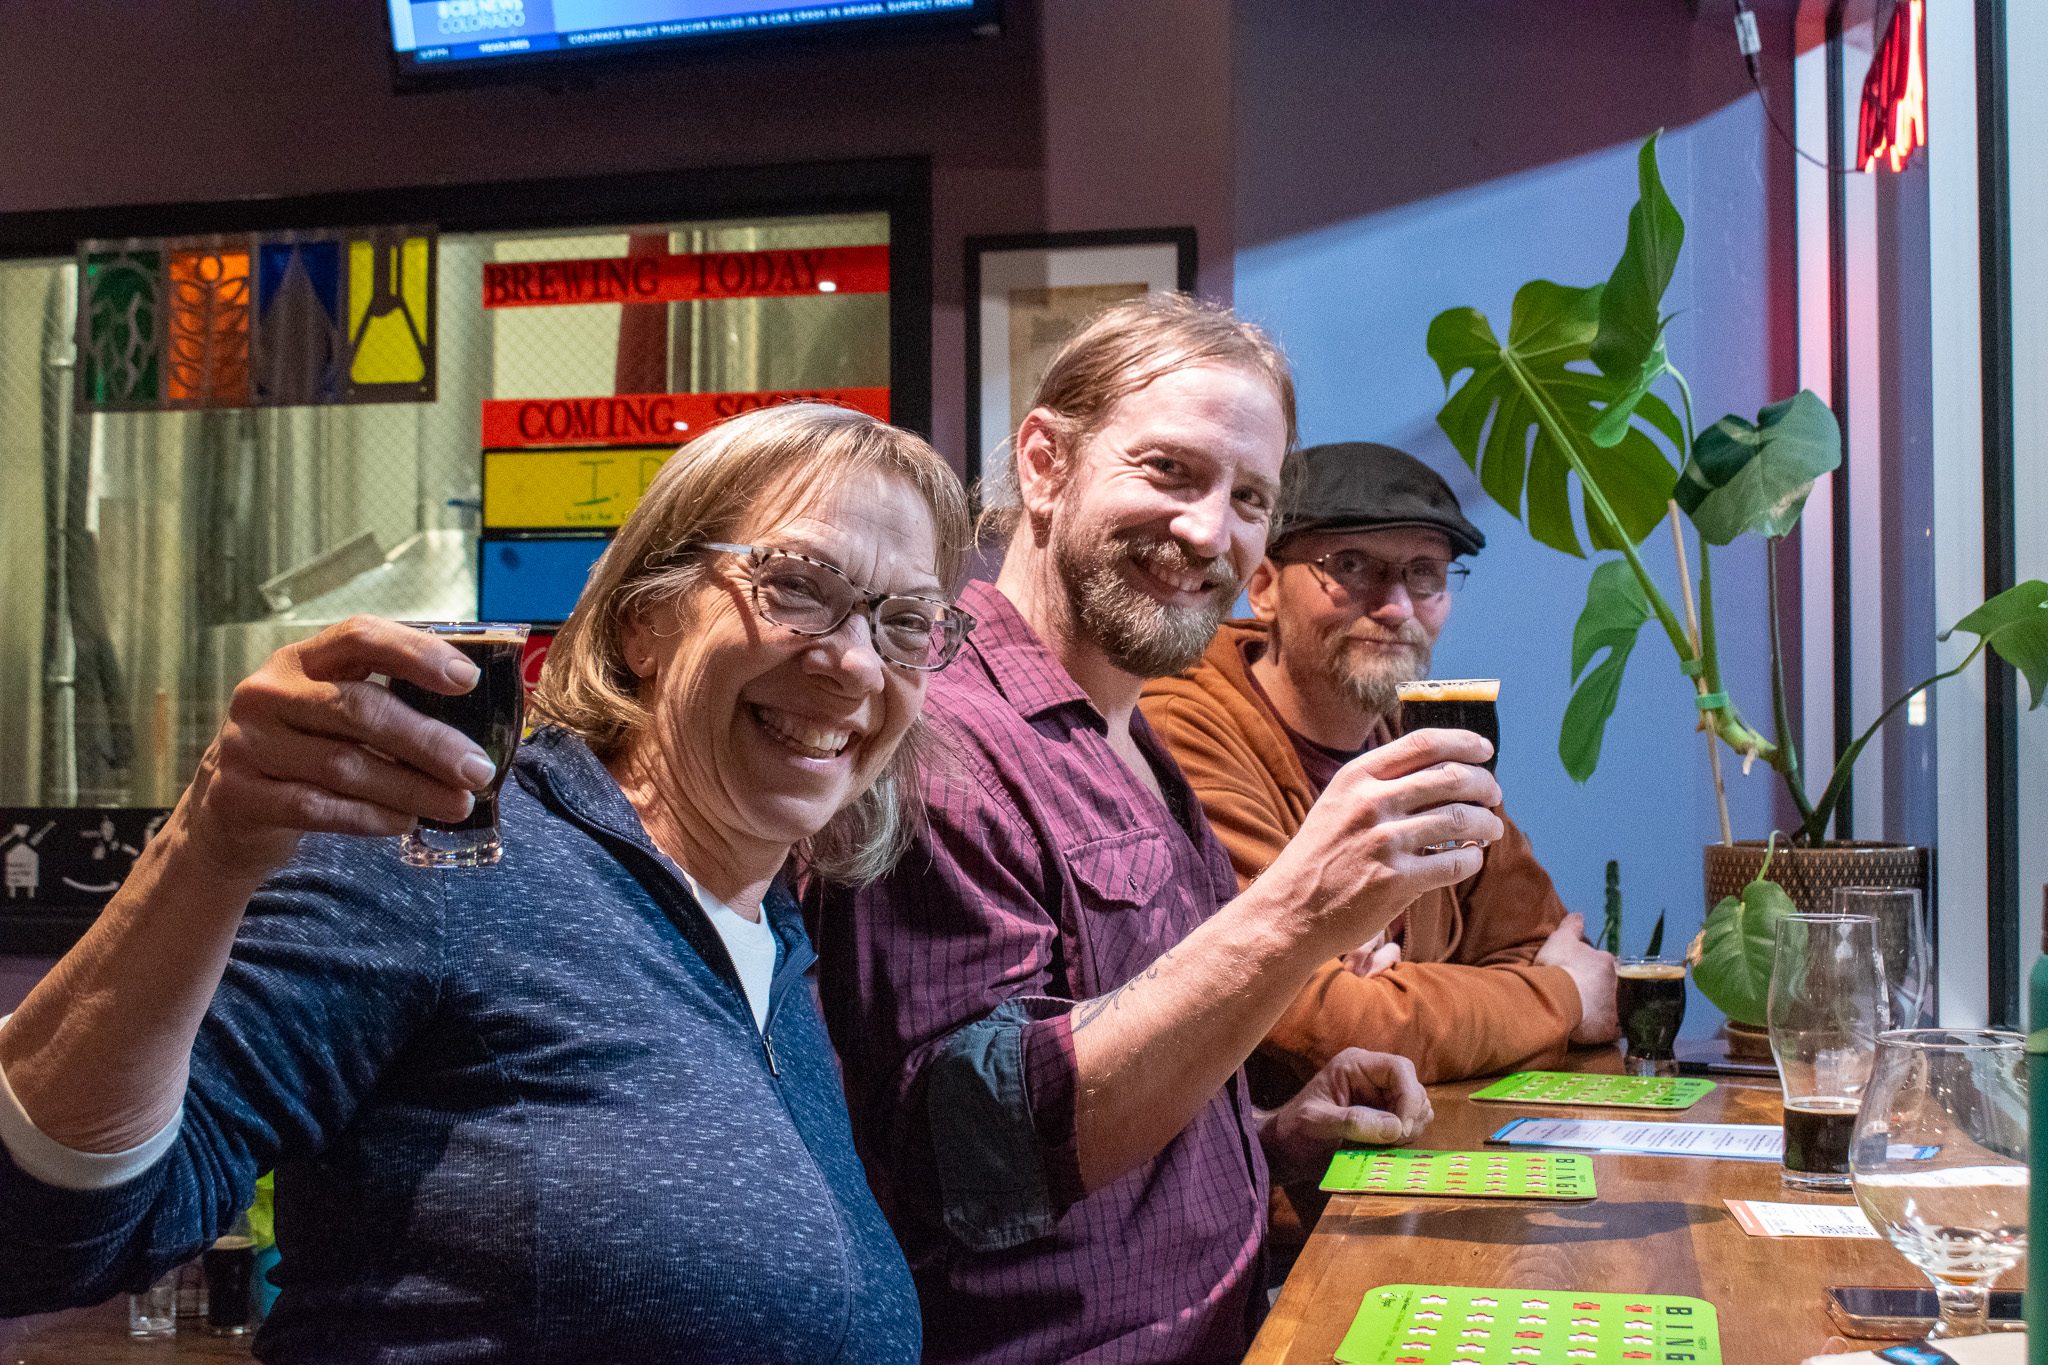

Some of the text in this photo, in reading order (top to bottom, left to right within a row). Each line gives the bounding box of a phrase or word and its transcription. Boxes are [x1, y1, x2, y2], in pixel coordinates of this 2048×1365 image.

[437, 11, 526, 34] COLORADO
[486, 251, 824, 304] BREWING TODAY
[518, 400, 676, 439] COMING
